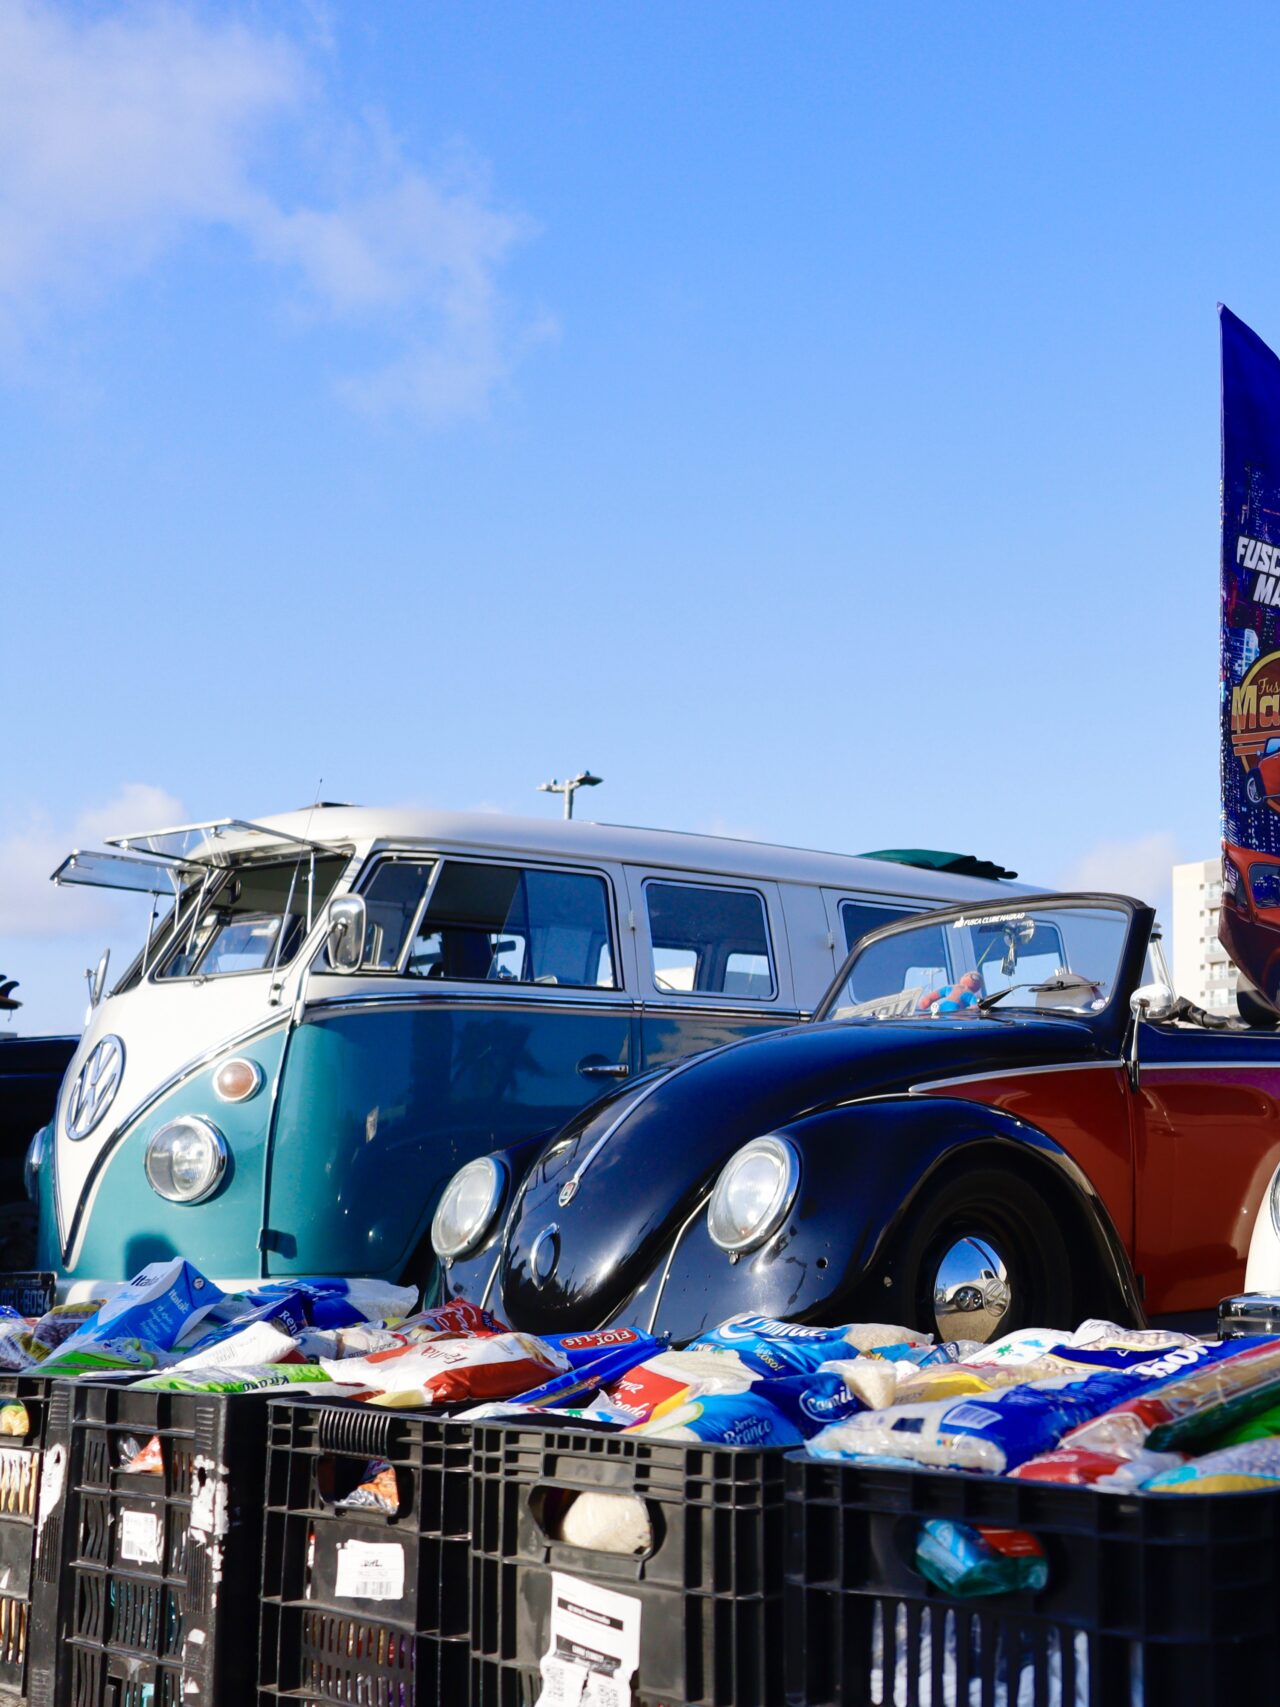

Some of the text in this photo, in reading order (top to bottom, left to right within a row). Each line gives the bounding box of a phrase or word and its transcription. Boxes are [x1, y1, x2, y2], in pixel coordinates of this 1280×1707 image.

[597, 1331, 631, 1346] Flor
[806, 1385, 856, 1414] Camil
[723, 1420, 772, 1445] Branco
